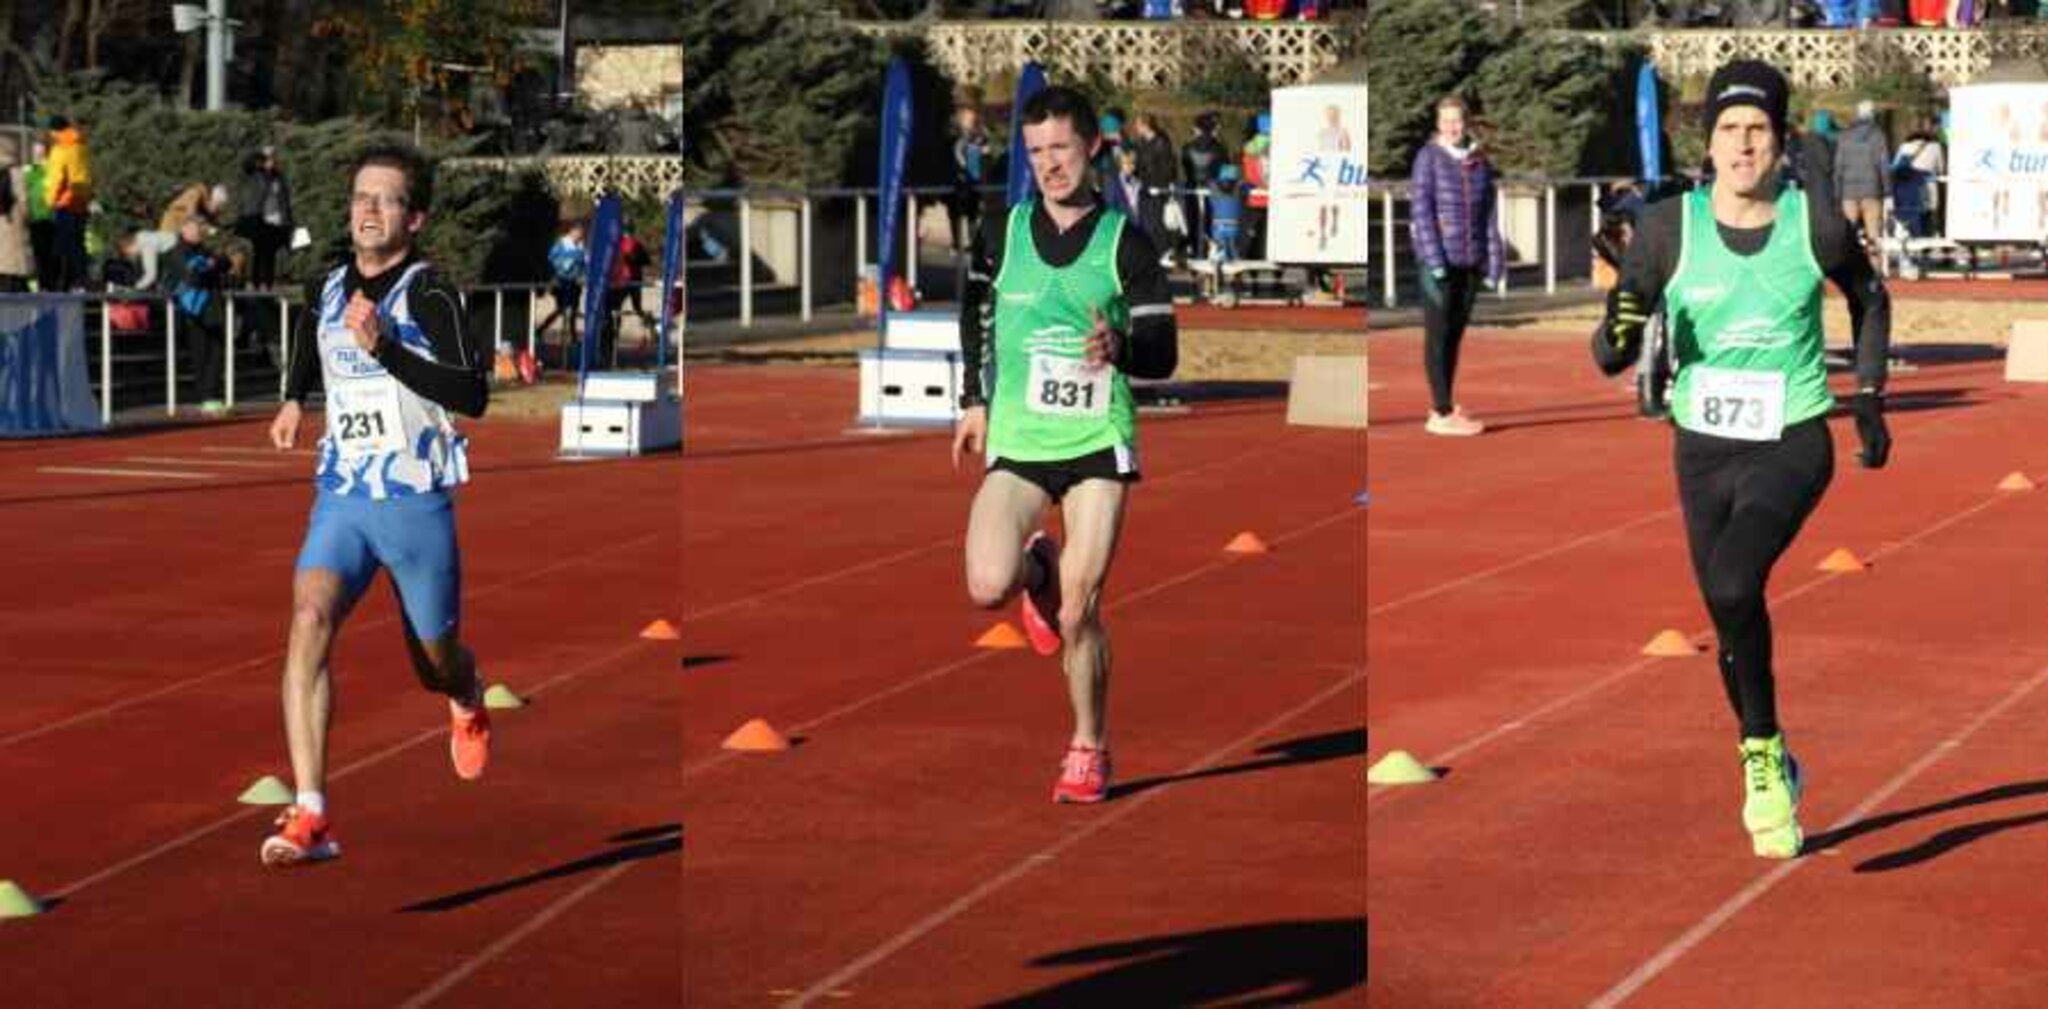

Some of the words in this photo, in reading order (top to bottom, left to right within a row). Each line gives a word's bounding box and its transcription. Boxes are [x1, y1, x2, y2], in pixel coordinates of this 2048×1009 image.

[1040, 379, 1095, 409] 831
[338, 409, 386, 441] 231
[1702, 396, 1766, 430] 873
